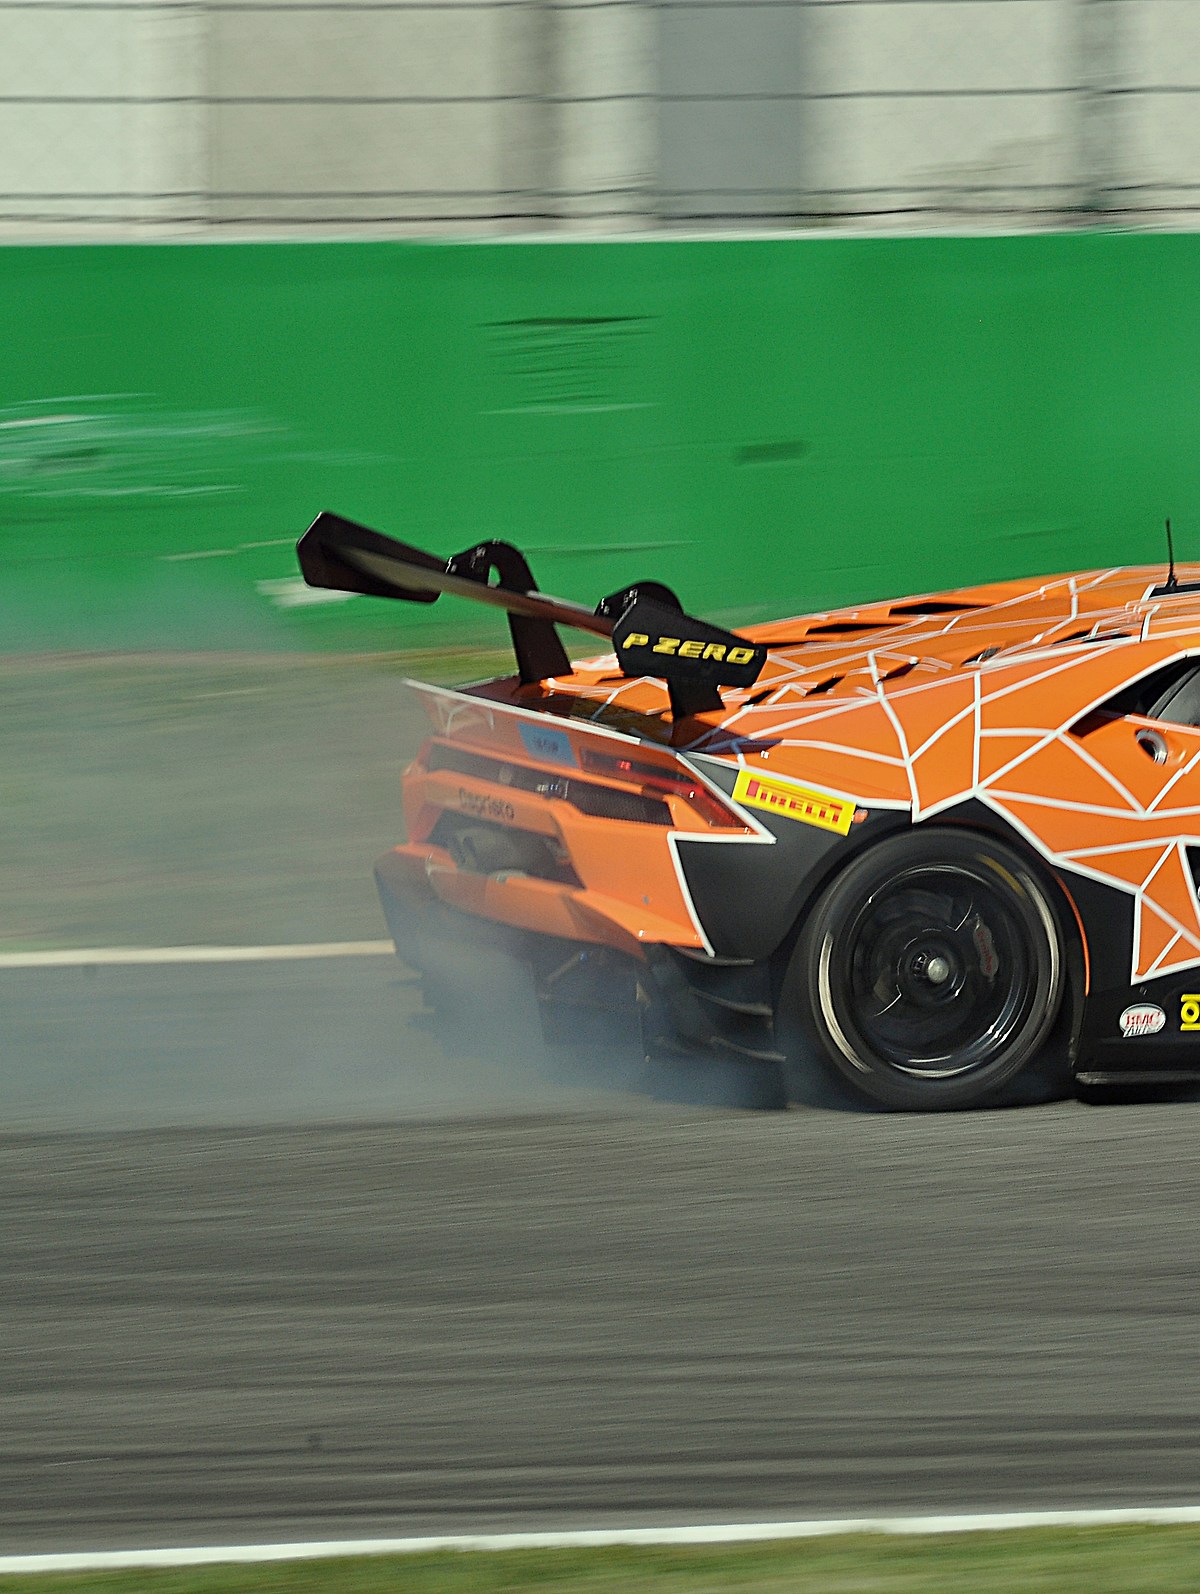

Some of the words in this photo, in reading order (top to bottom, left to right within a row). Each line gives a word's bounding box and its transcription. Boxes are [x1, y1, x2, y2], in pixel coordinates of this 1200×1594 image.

[623, 632, 649, 649] P
[652, 637, 755, 665] ZERO
[746, 779, 843, 823] PIRELLI
